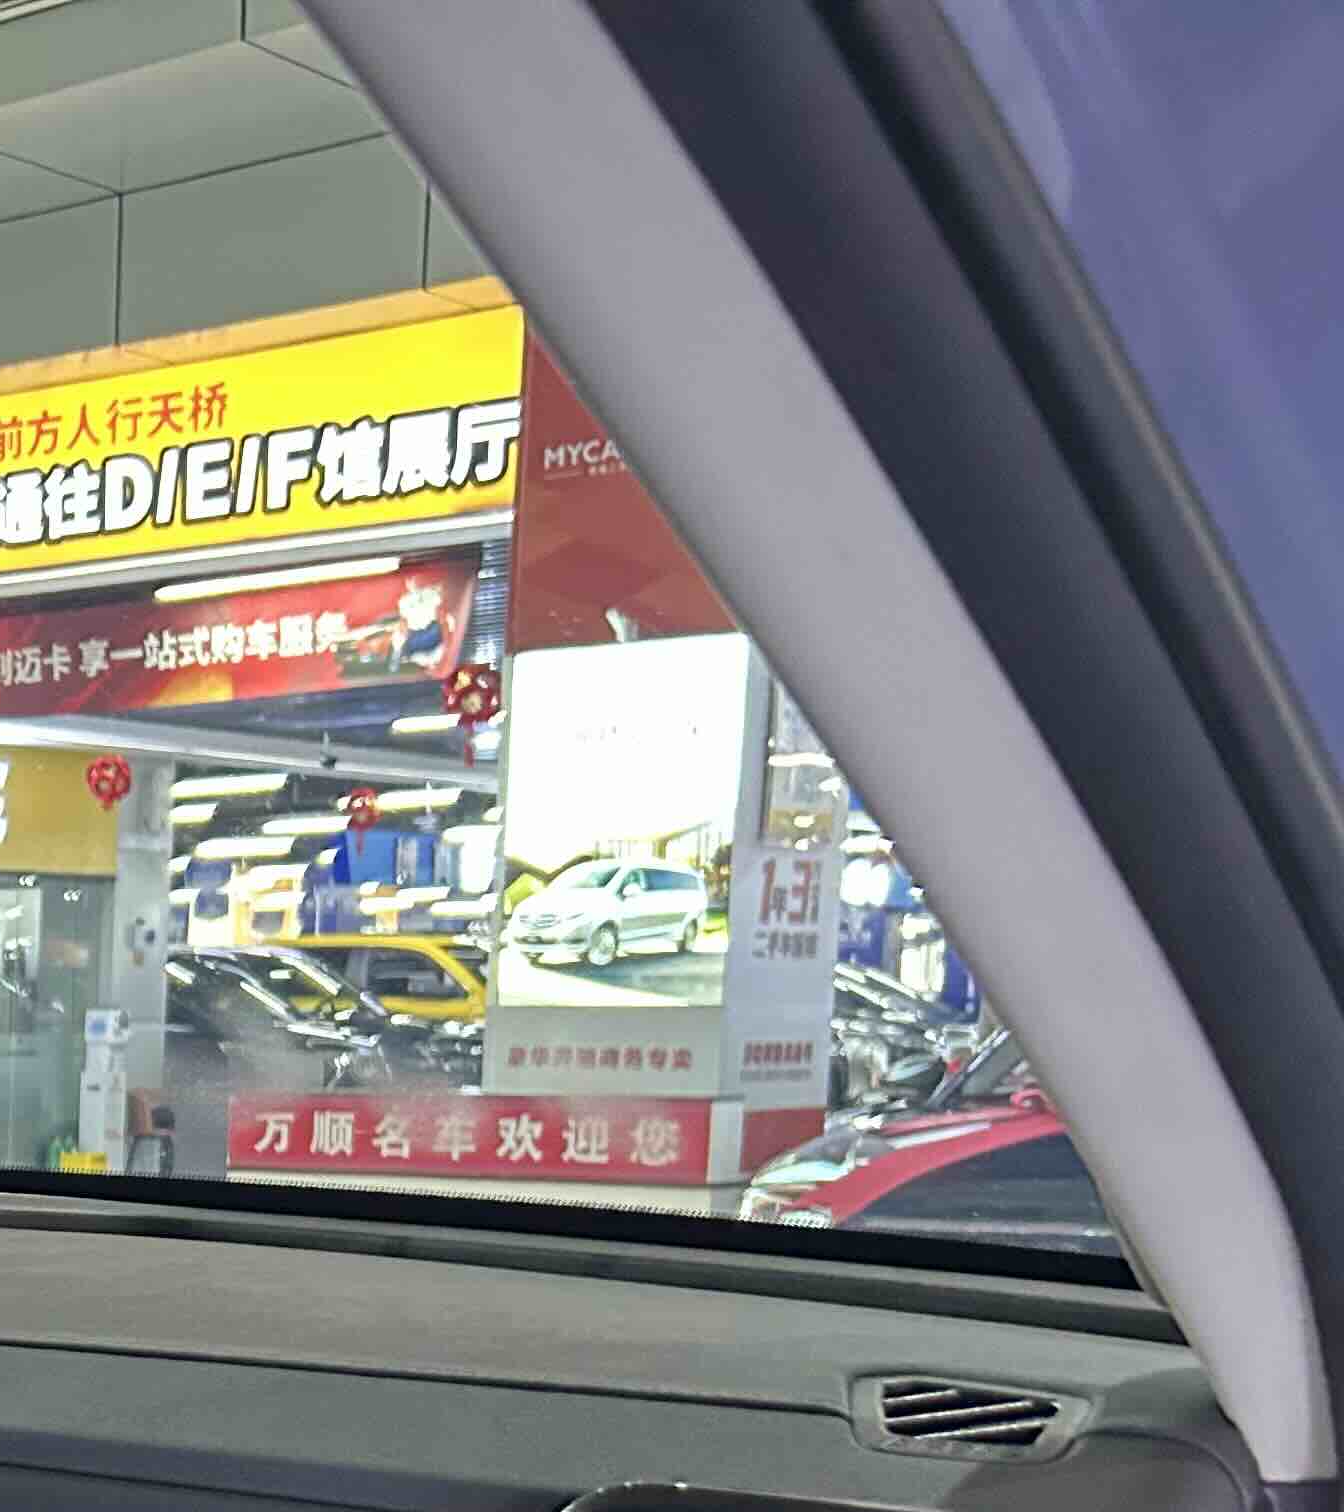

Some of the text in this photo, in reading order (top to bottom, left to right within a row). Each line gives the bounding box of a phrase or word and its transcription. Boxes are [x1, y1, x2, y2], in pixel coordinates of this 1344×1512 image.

[79, 611, 349, 678] 享一站式购车服务
[254, 1111, 681, 1165] 万顺名车欢迎您
